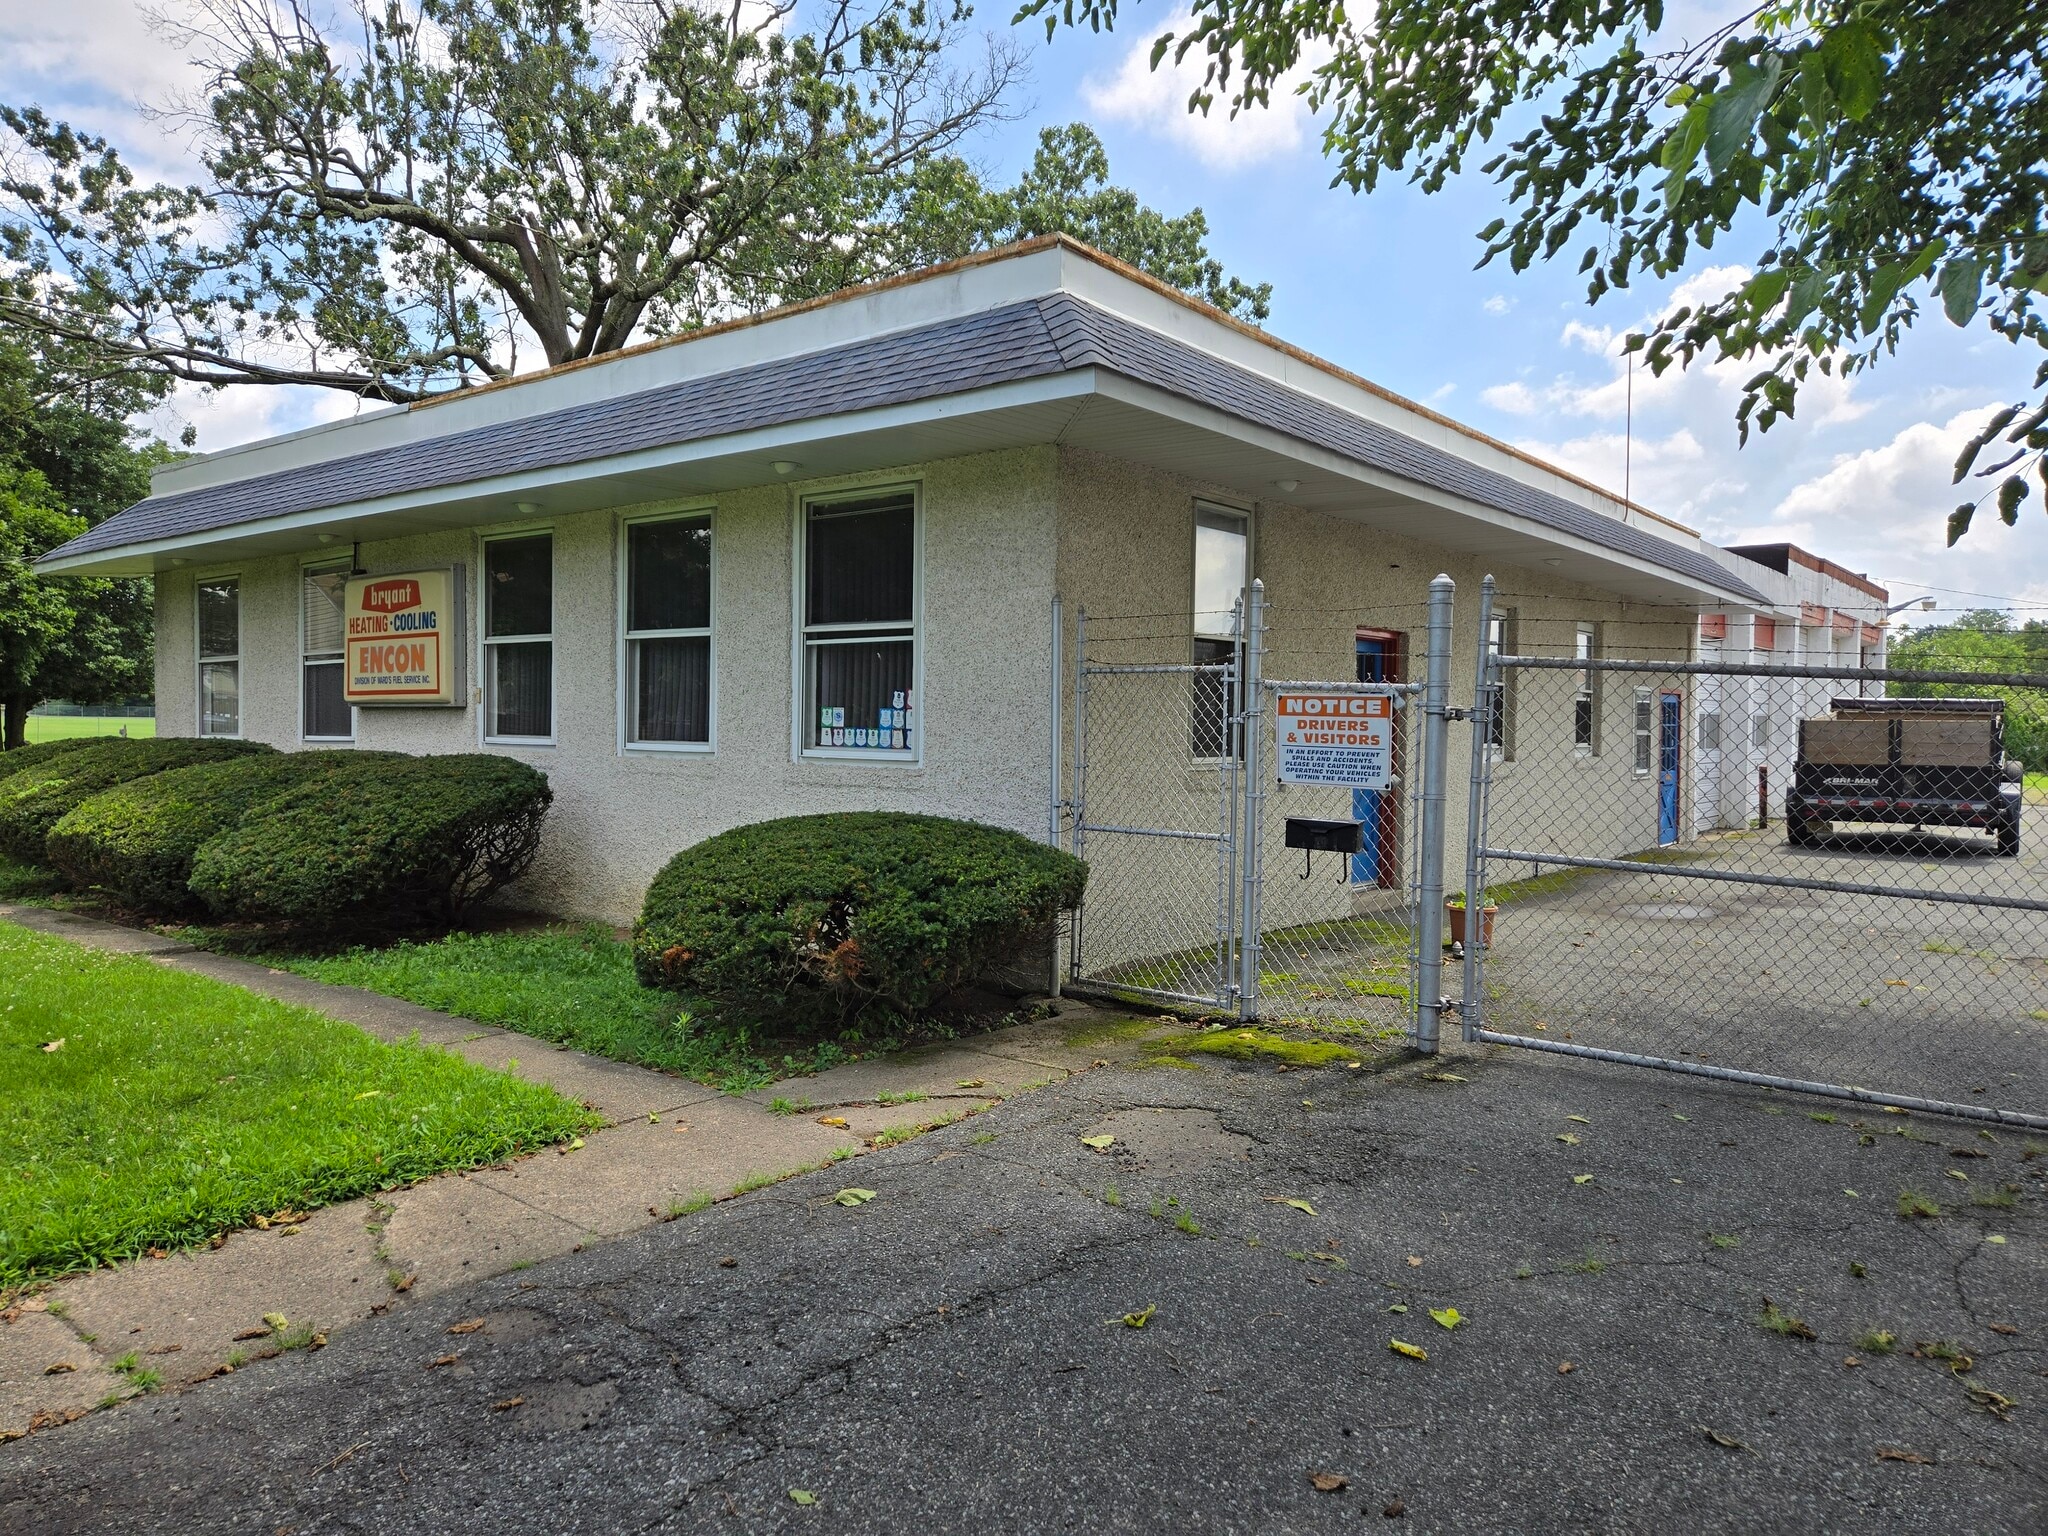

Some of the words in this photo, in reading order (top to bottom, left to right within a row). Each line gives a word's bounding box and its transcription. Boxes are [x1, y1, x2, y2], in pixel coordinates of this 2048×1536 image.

[371, 584, 411, 609] bryant
[349, 615, 388, 634] HEATING
[394, 611, 437, 632] COOLING
[359, 644, 426, 674] ENCON
[354, 676, 369, 685] DIVISION
[371, 676, 376, 684] OF
[392, 675, 403, 684] FUEL
[404, 675, 420, 684] SERVICE
[1286, 698, 1382, 715] NOTICE
[1297, 719, 1369, 731] DRIVERS
[1286, 732, 1298, 743] &
[1303, 733, 1380, 746] VISITORS
[1332, 757, 1374, 765] ACCIDENTS,
[1346, 769, 1381, 777] VEHICLES
